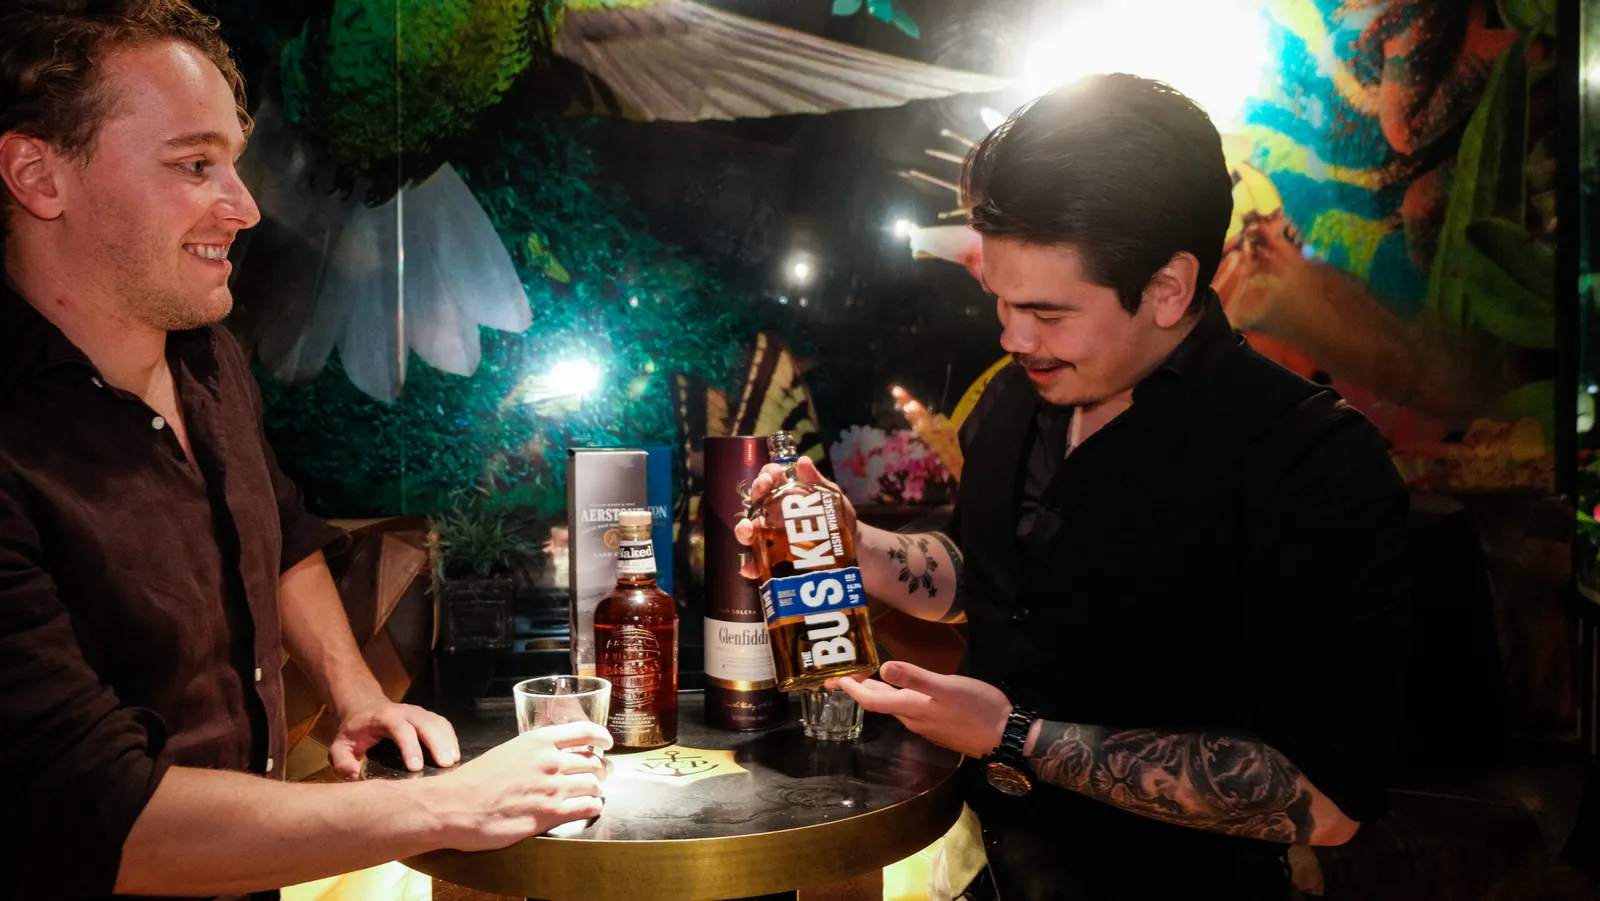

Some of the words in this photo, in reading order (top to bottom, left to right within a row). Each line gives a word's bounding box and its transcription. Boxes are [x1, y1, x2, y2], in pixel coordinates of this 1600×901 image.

[581, 507, 646, 522] AERST
[821, 493, 838, 530] WHISKEY
[619, 544, 652, 560] Naked
[831, 532, 844, 557] IRISH
[718, 626, 769, 645] Glenfiddi
[801, 650, 814, 669] THE
